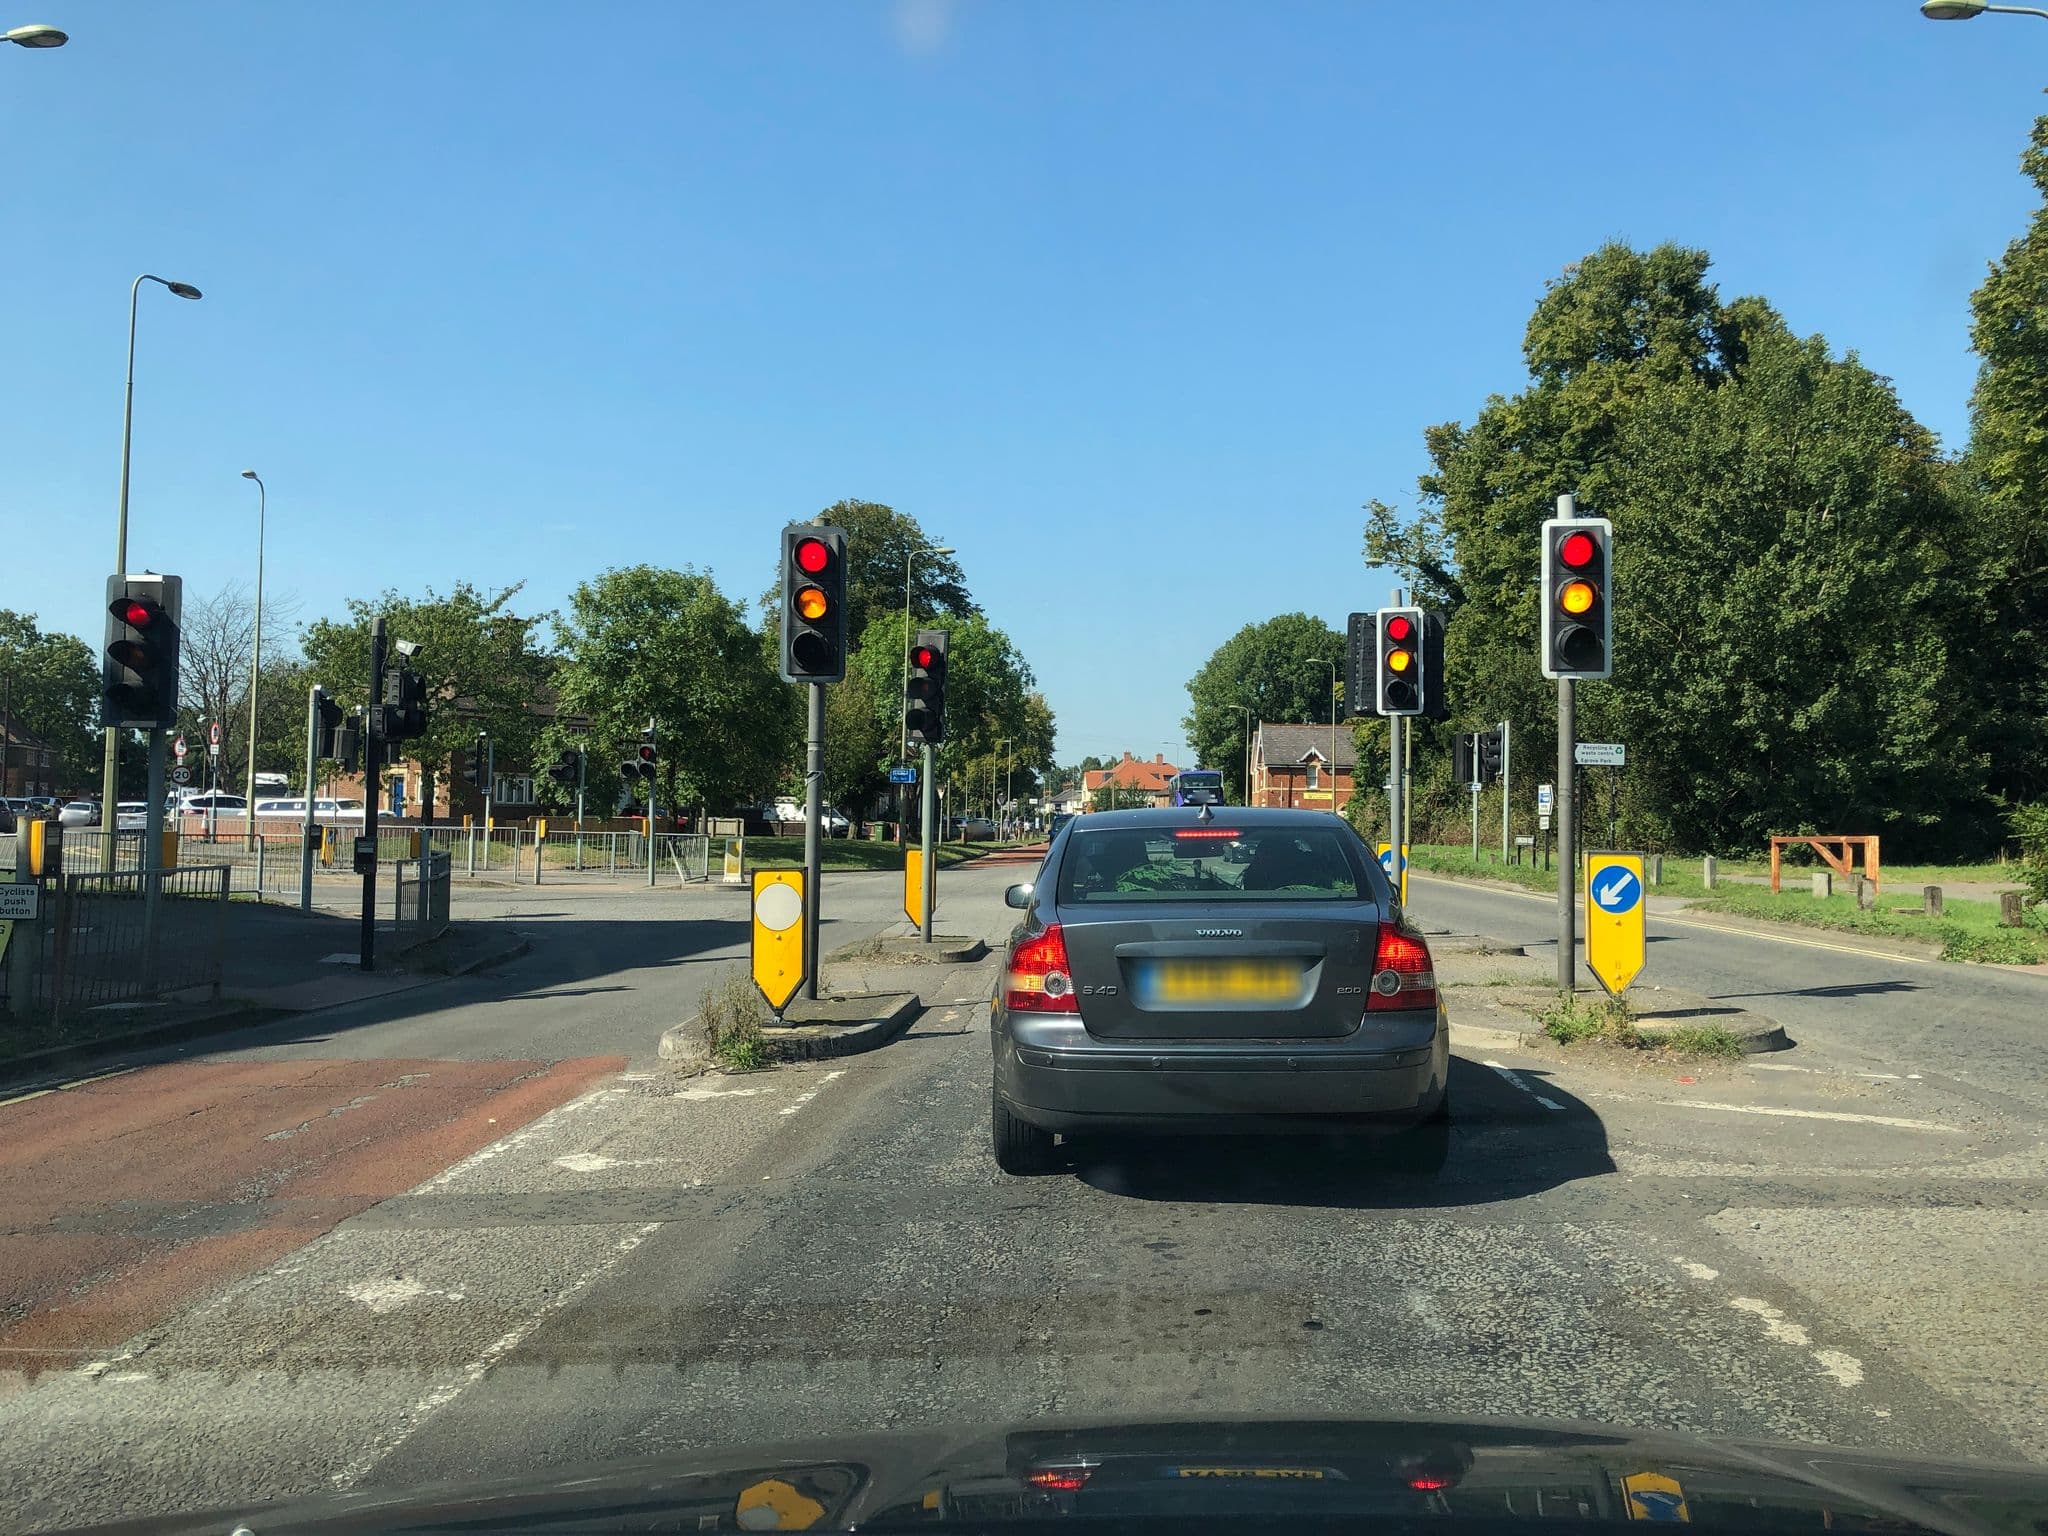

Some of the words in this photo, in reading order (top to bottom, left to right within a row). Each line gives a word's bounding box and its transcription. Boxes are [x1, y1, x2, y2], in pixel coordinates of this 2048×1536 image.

[174, 771, 189, 779] 20
[0, 887, 35, 896] Cyclists
[4, 898, 27, 906] push
[0, 907, 31, 915] button
[1195, 929, 1242, 937] VOLVO
